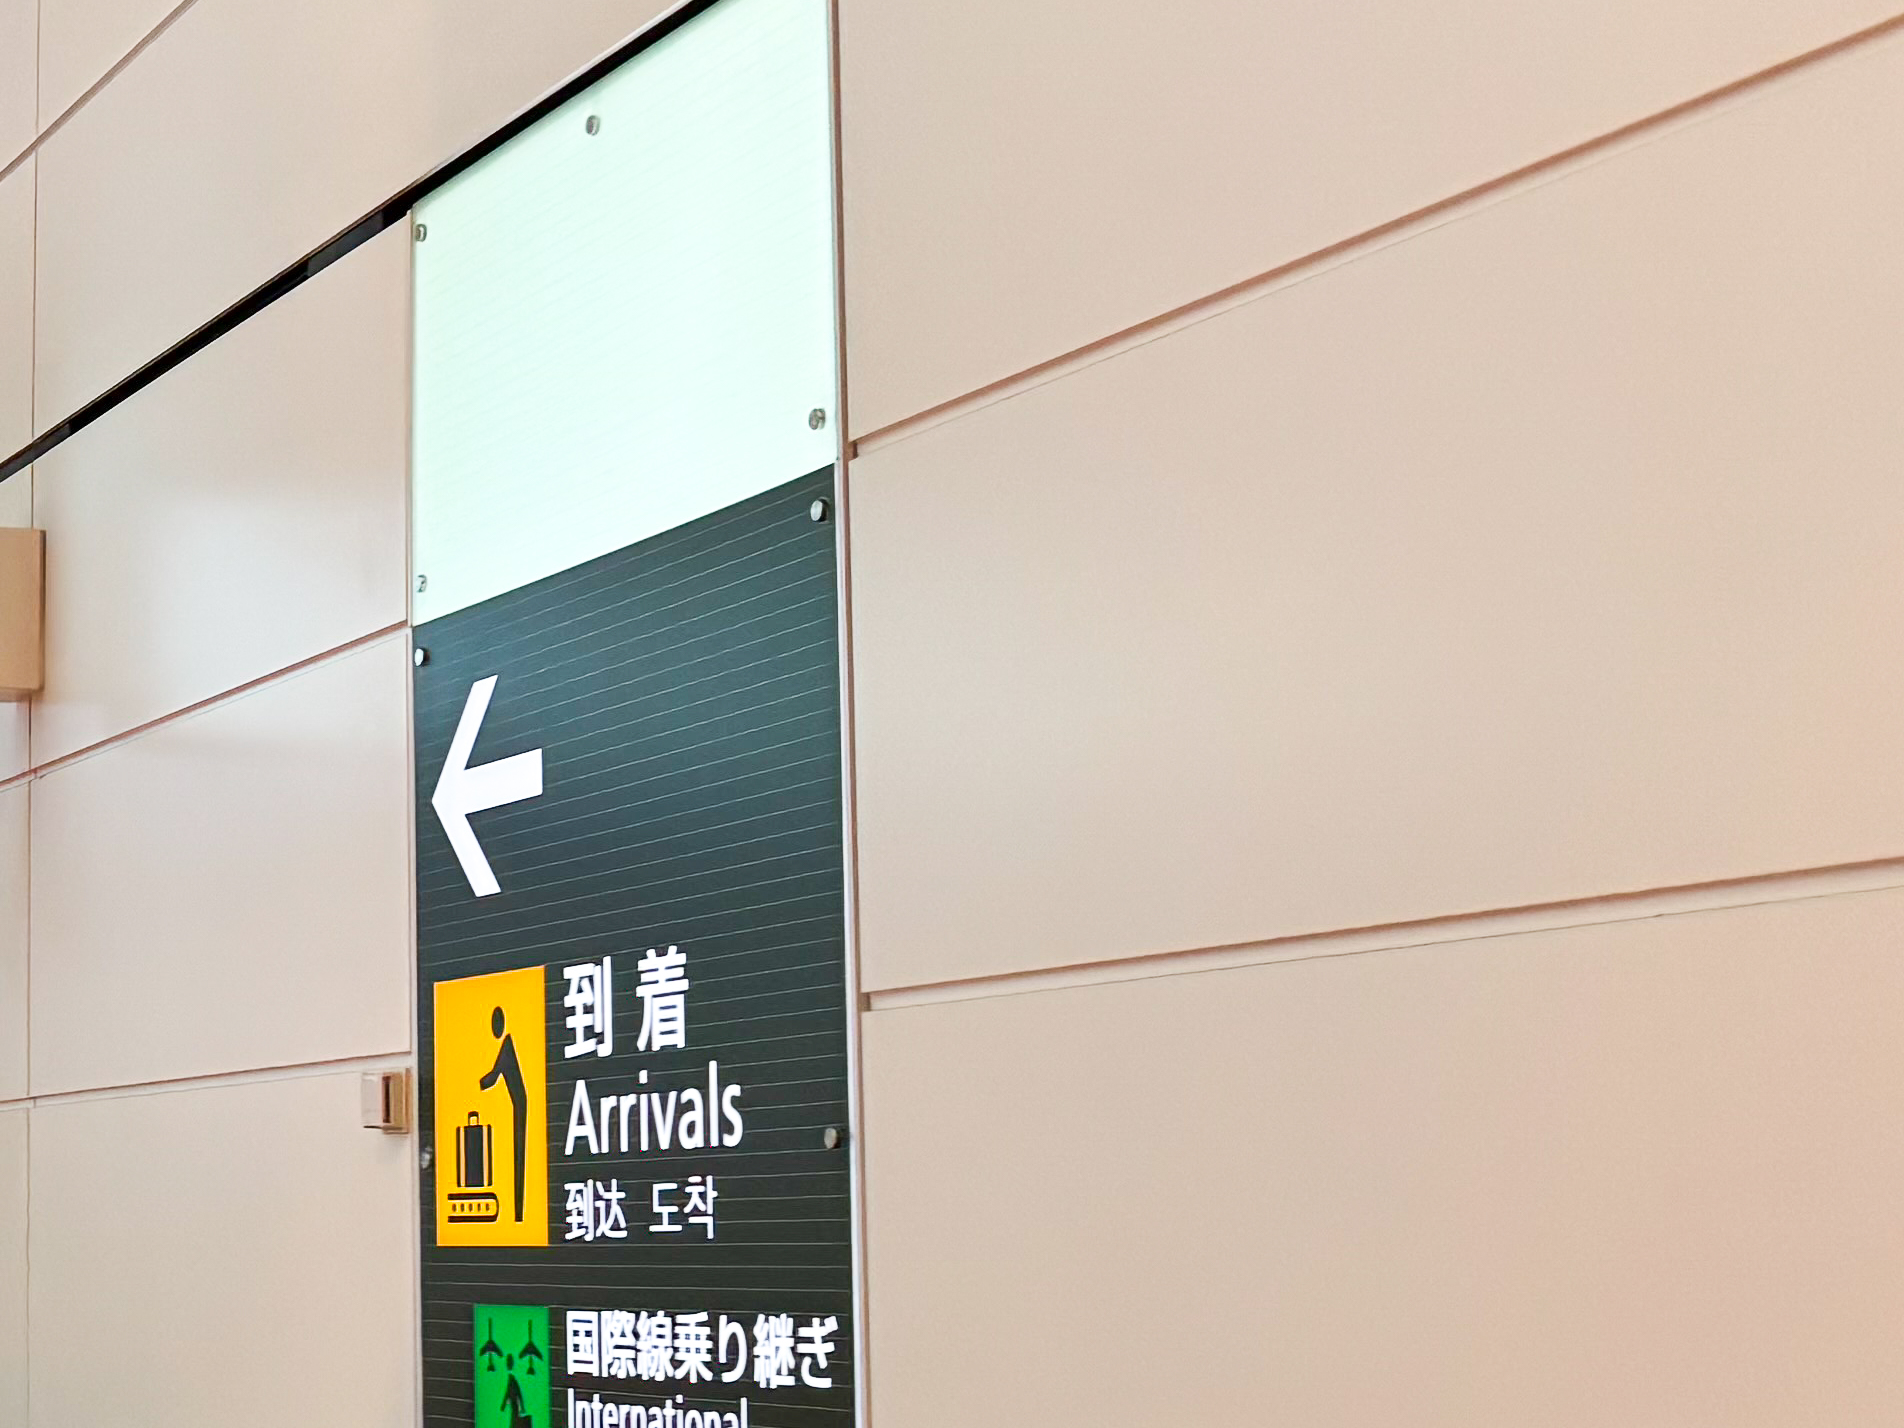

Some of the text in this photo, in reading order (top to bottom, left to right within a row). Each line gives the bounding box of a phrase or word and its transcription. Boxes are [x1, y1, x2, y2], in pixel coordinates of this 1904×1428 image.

[563, 945, 689, 1059] 到着
[564, 1060, 743, 1155] Arrivals
[563, 1178, 628, 1242] 到达
[649, 1175, 718, 1240] 도착
[566, 1310, 839, 1389] 国際線乗り継ぎ
